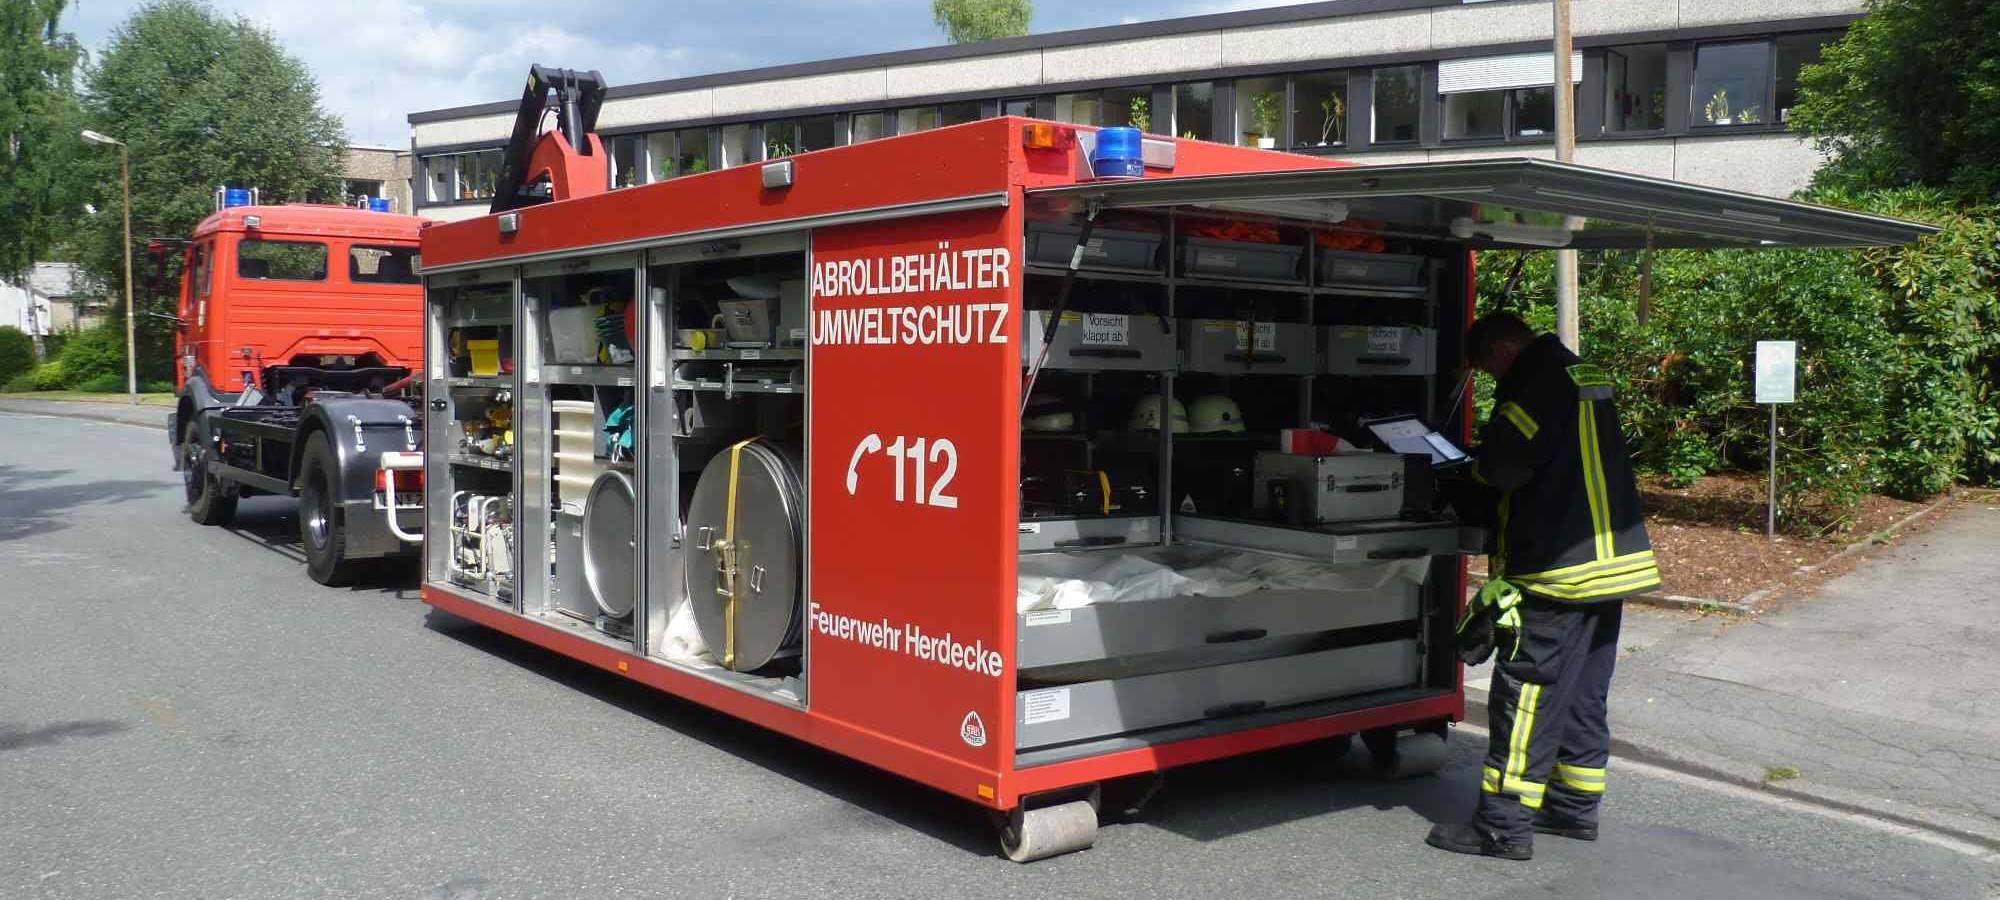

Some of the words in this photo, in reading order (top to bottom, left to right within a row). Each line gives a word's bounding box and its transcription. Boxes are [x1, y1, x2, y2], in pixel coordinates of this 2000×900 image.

[811, 241, 1011, 298] ABROLLBEHÄLTER
[811, 302, 1009, 346] UMWELTSCHUTZ
[1087, 313, 1122, 326] Vorsicht
[886, 435, 958, 509] 112
[810, 602, 902, 652] Feuerwehr
[905, 623, 1003, 677] Herdecke
